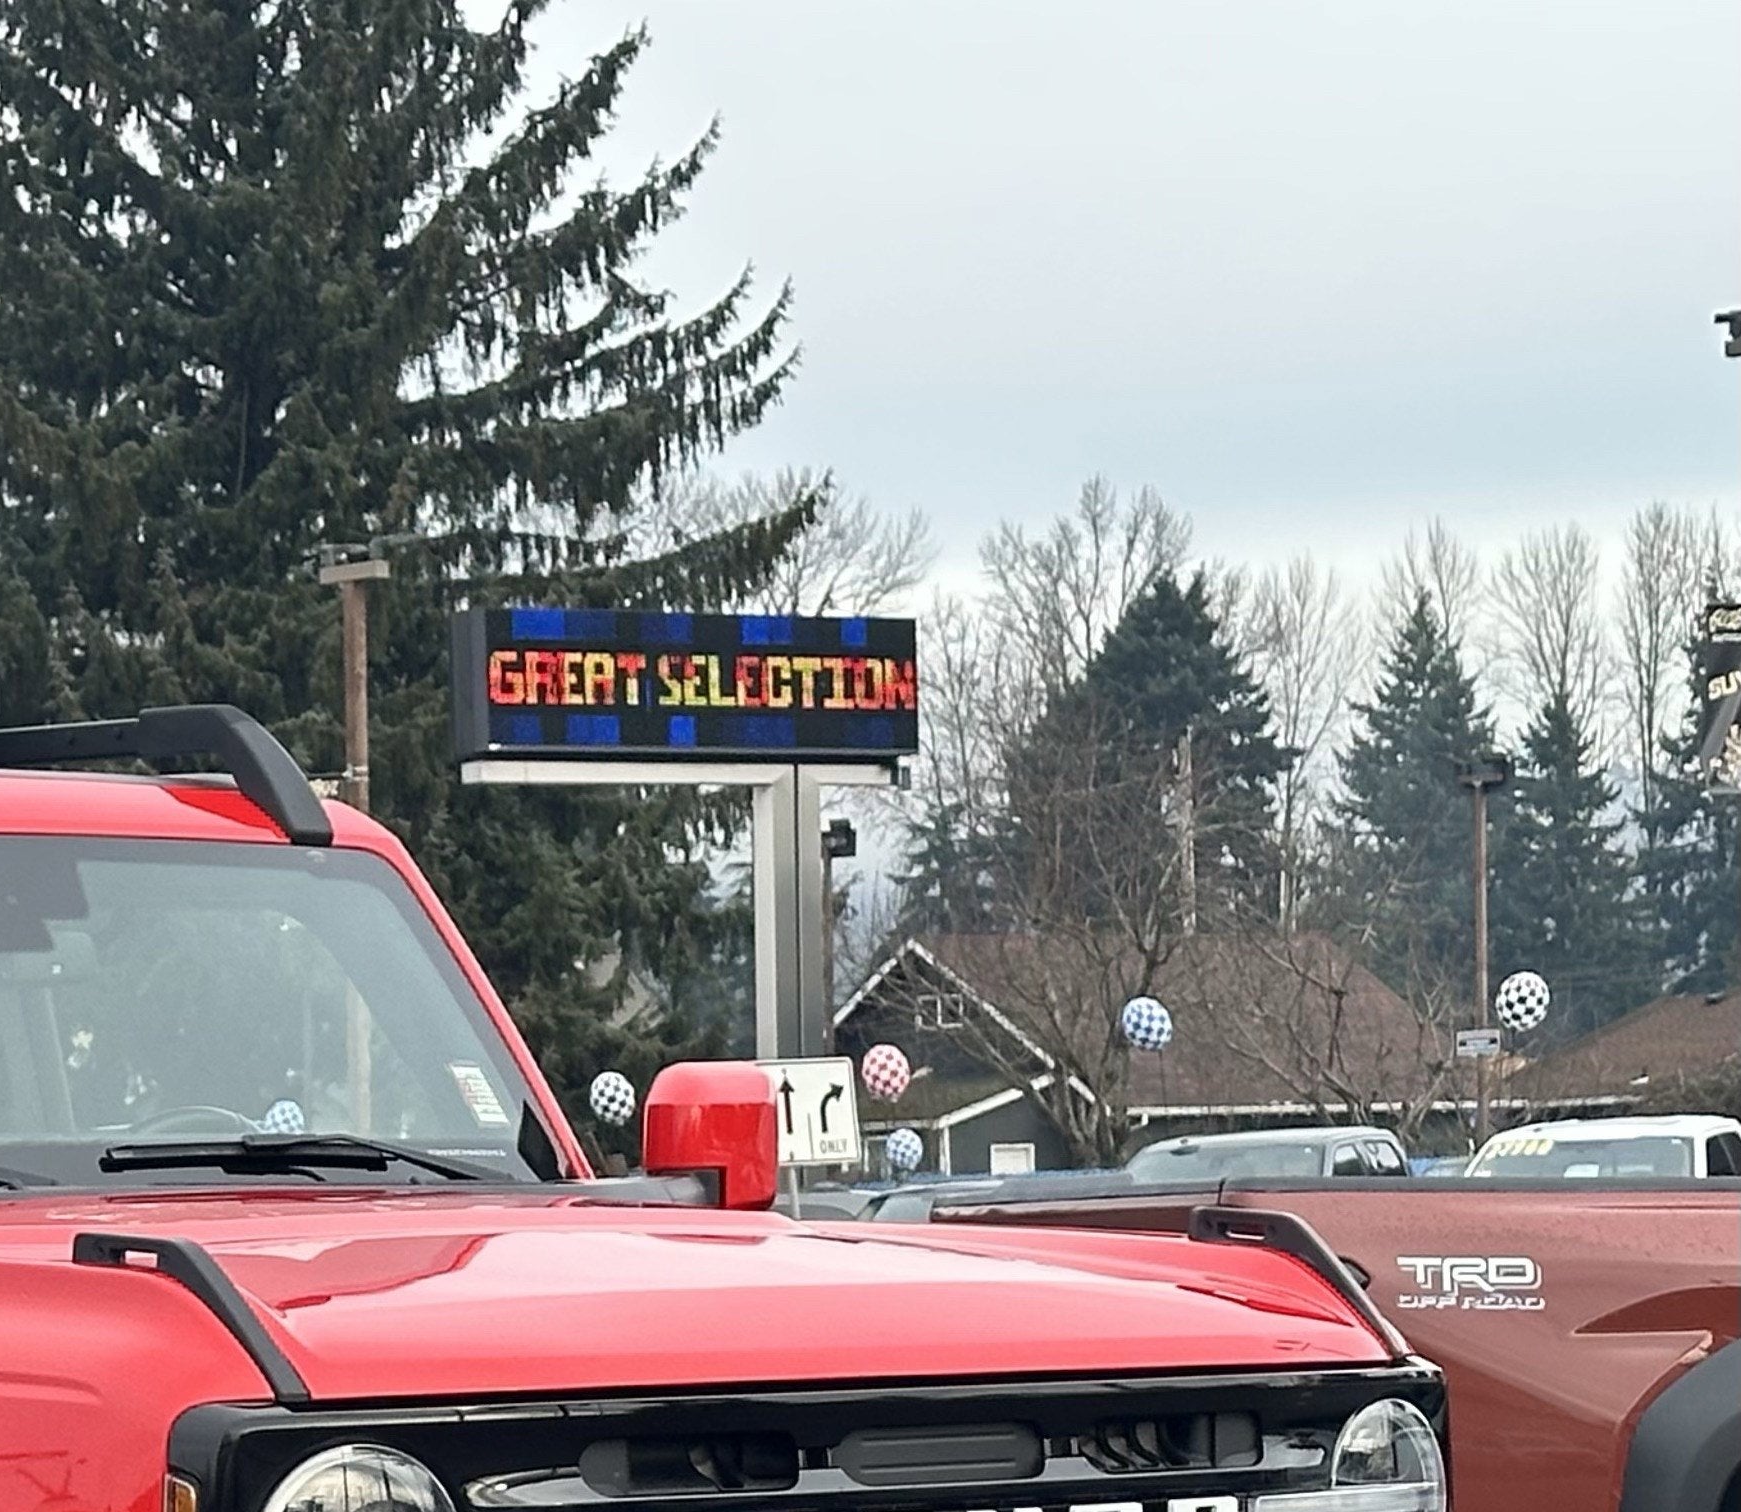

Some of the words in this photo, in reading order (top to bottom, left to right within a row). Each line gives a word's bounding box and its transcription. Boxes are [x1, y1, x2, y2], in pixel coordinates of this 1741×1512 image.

[488, 650, 645, 705] GREAT
[658, 655, 917, 710] SELECTION
[820, 1139, 847, 1154] ONLY
[1396, 1256, 1542, 1293] TRD
[1396, 1294, 1457, 1309] OFF
[1461, 1294, 1546, 1310] ROAD
